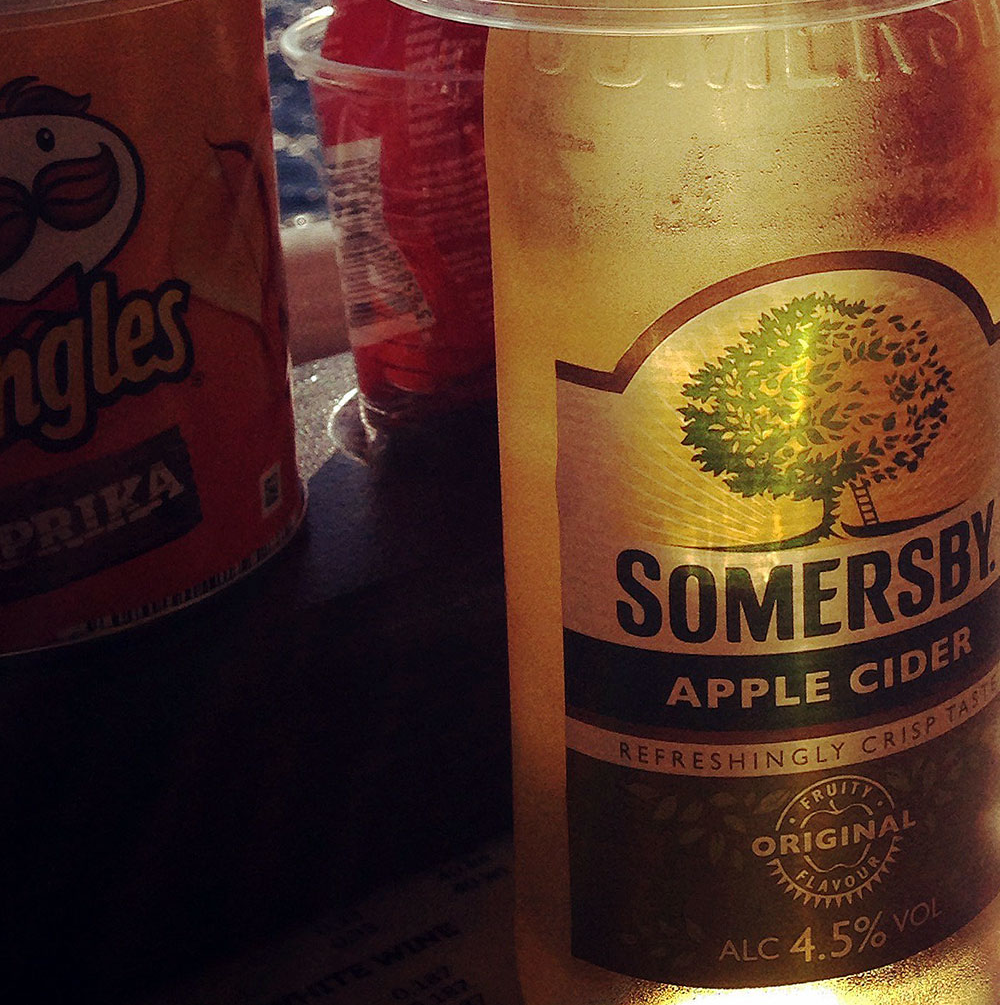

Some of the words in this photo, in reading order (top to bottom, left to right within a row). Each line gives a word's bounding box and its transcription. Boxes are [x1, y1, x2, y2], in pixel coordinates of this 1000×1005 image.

[0, 276, 188, 443] ngles
[0, 459, 185, 563] PRIKA
[666, 670, 831, 709] APPLE
[849, 626, 973, 695] CIDER
[619, 741, 845, 772] REFRESHINGLY
[862, 716, 937, 755] CRISP
[945, 678, 999, 718] TASTE
[799, 780, 873, 811] FRUITY
[751, 809, 917, 858] ORIGINAL
[796, 854, 880, 893] FLAVOUR
[371, 921, 461, 965] WINE
[719, 936, 780, 962] ALC
[789, 910, 887, 963] 4.5%
[892, 898, 943, 934] VOL
